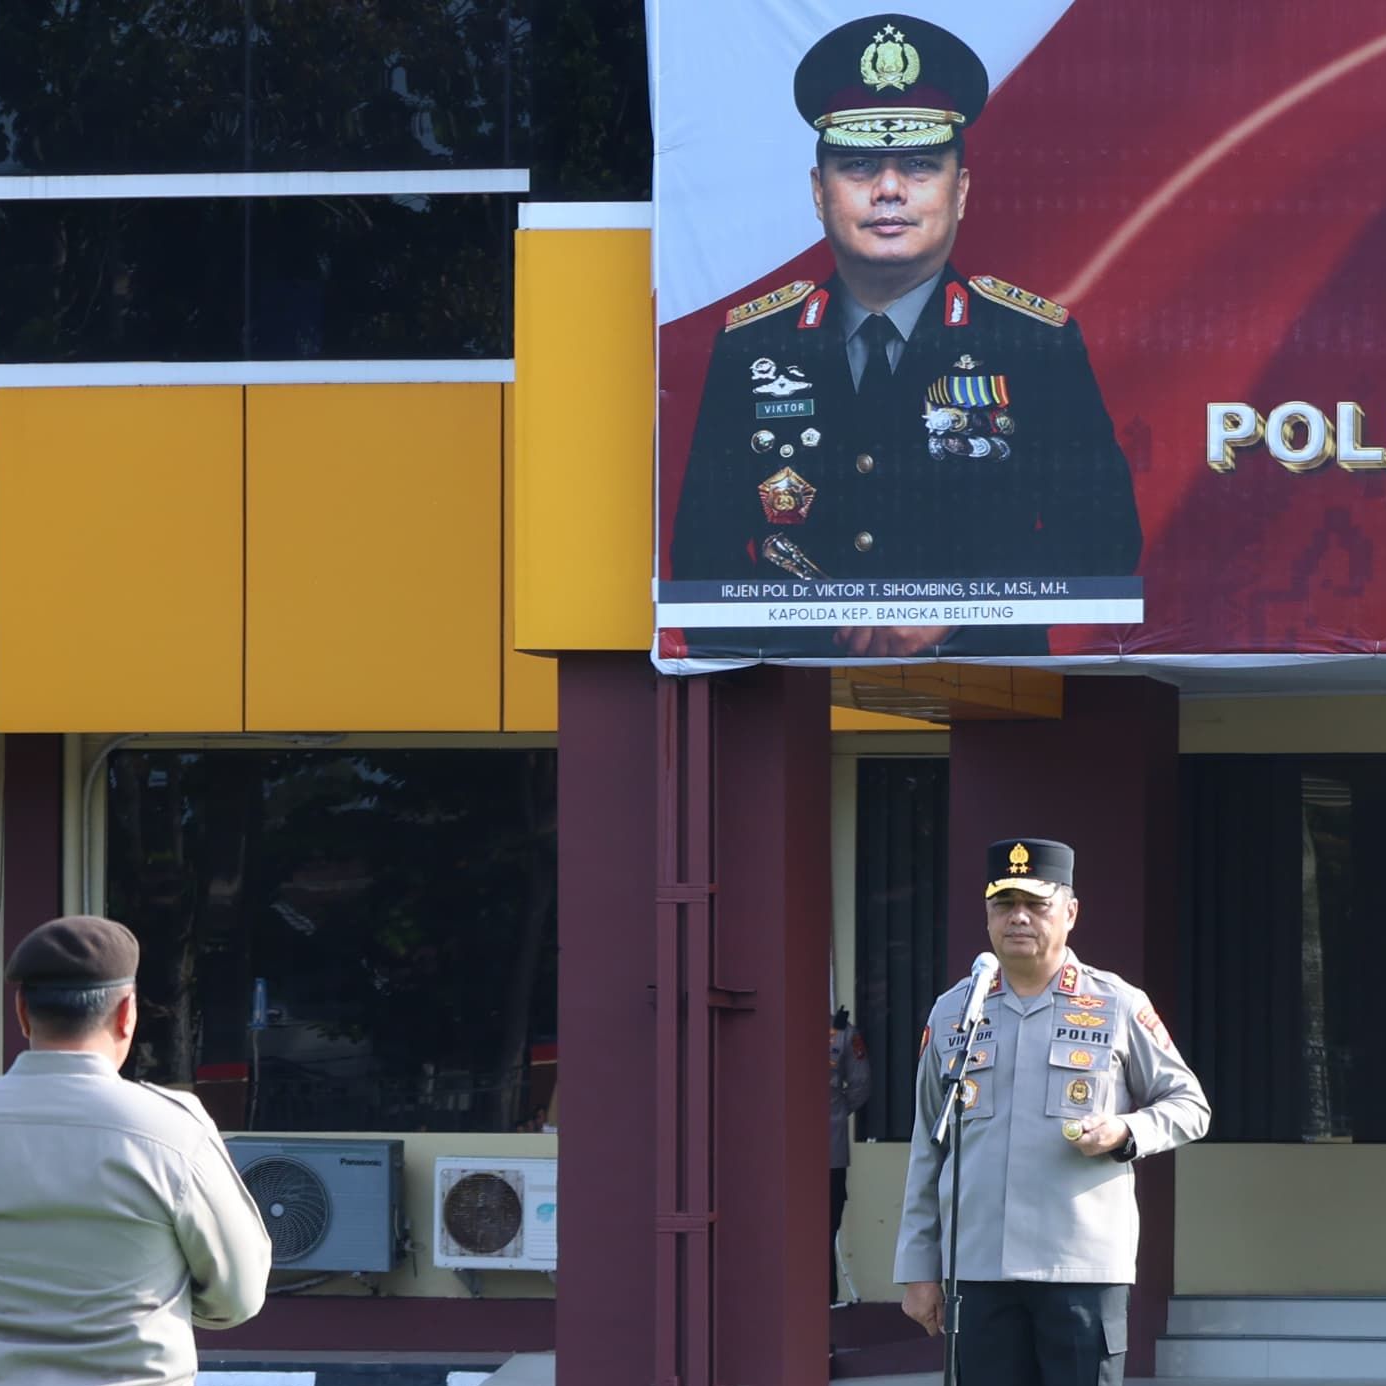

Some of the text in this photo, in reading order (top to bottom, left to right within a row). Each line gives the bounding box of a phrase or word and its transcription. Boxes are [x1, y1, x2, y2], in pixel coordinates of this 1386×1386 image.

[764, 402, 805, 414] VIKTOR
[721, 581, 1069, 598] IRJEN POL Dr. VIKTOR T. SIHOMBING, S.I.K., M.Si., M.H.
[768, 606, 1014, 621] KAPOLDA KEP. BANGKA BELITUNG
[1056, 1027, 1109, 1045] POLRI
